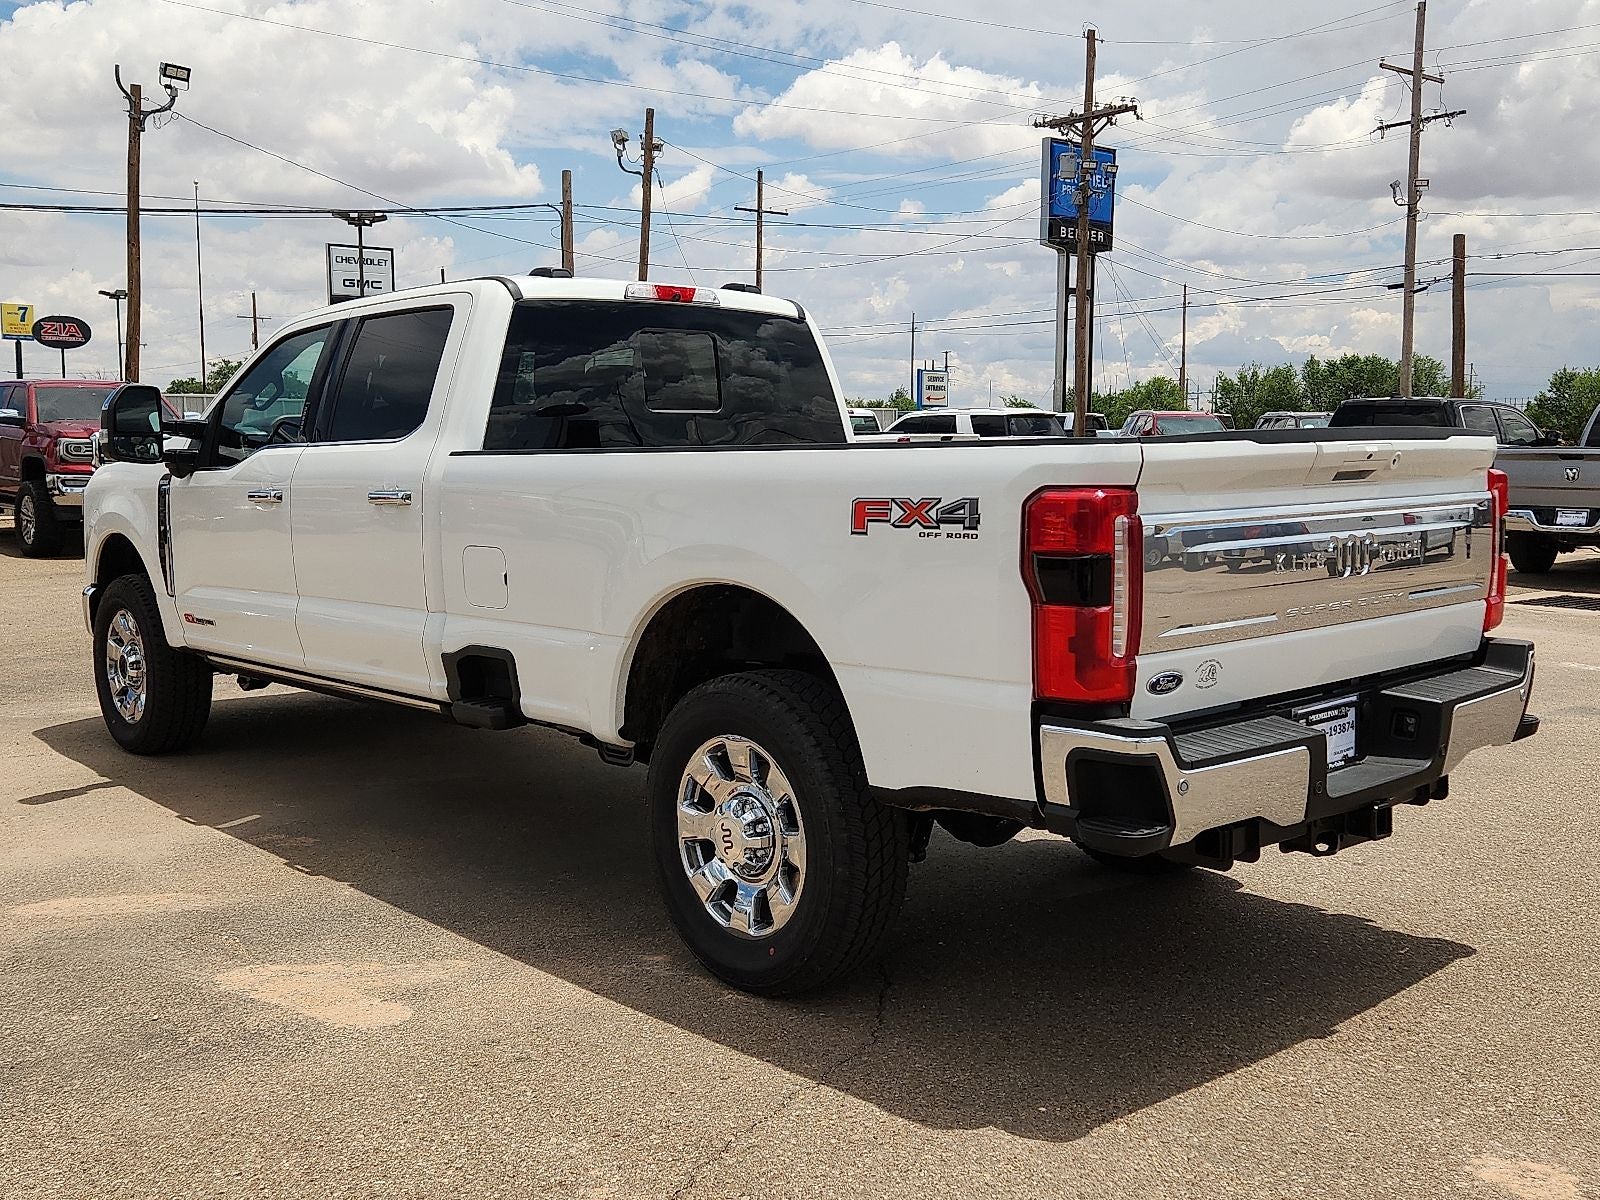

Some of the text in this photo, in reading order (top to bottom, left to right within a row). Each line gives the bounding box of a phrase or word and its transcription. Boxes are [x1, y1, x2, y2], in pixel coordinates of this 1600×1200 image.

[1061, 227, 1104, 242] BEER
[335, 255, 389, 266] CHEVROLET
[342, 278, 383, 290] GMC
[17, 306, 29, 323] 7
[40, 321, 83, 337] ZIA
[927, 375, 945, 383] SERVICE
[925, 384, 947, 392] ENTRANCE
[851, 497, 981, 535] FX4
[918, 531, 979, 540] OFF ROAD
[1378, 539, 1422, 562] RANCH
[1286, 592, 1405, 618] SUPER DUTY
[1156, 676, 1179, 691] Ford
